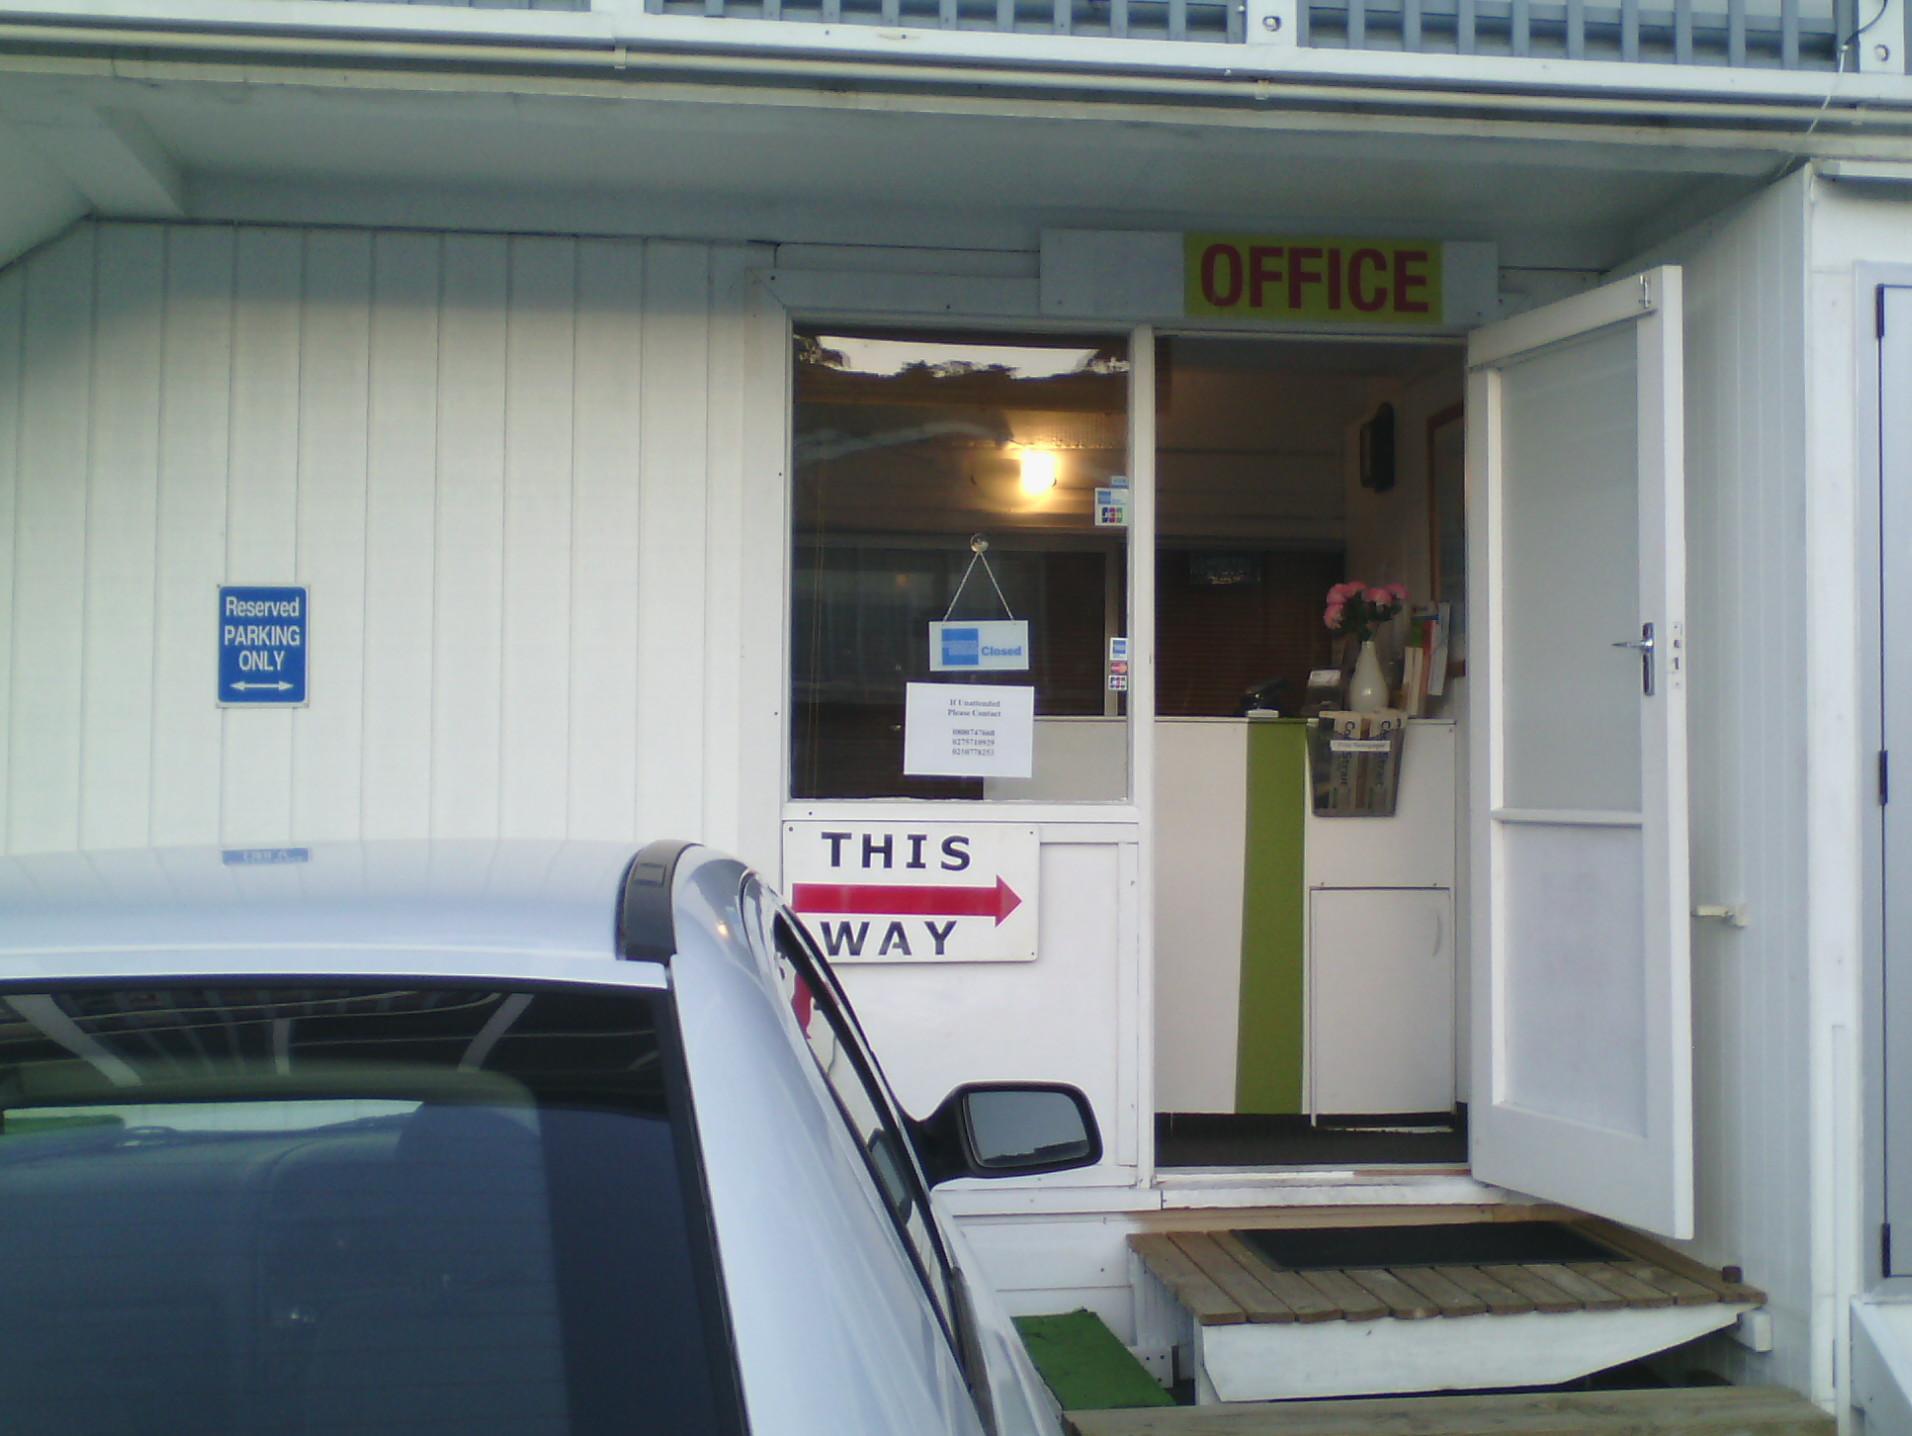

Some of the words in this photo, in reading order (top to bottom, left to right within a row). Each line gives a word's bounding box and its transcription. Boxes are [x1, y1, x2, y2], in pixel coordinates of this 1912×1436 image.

[1201, 243, 1429, 313] OFFICE
[225, 596, 300, 617] Reserved
[224, 625, 300, 646] PARKING
[238, 650, 285, 671] ONLY
[981, 646, 1022, 657] Closed
[947, 709, 970, 717] Please
[972, 709, 1001, 717] Contact
[821, 832, 971, 872] THIS
[820, 921, 957, 956] WAY
